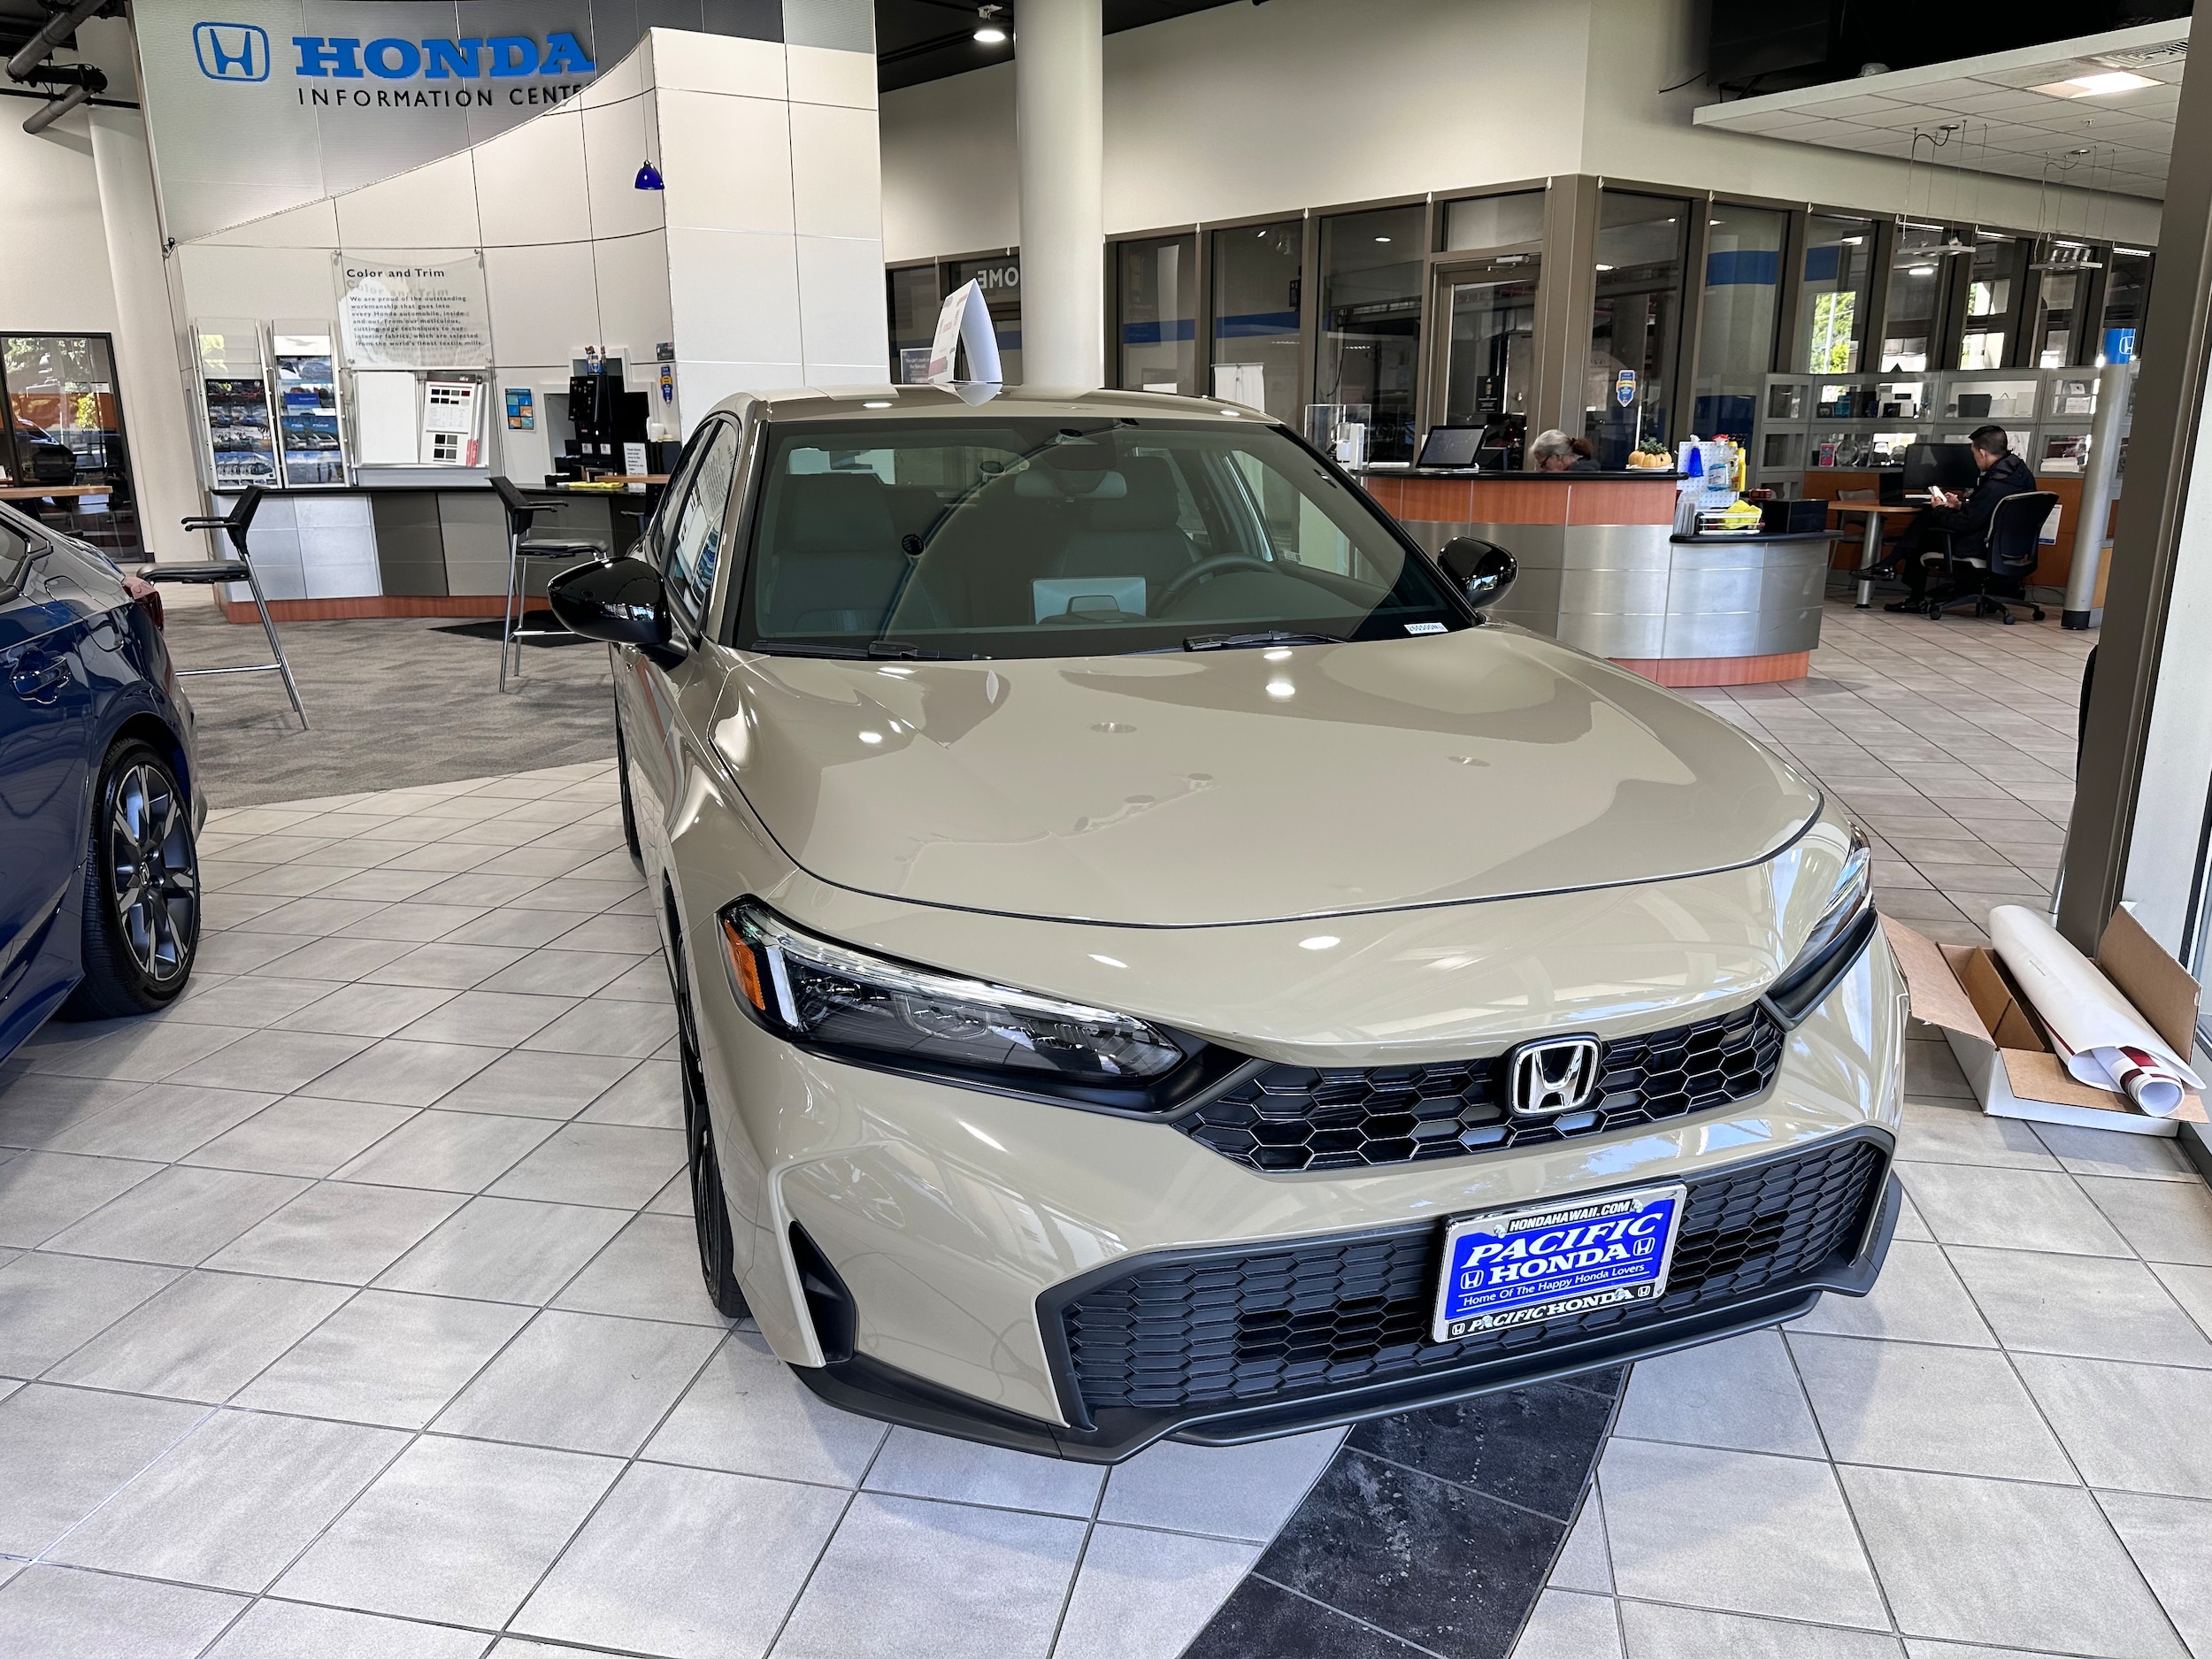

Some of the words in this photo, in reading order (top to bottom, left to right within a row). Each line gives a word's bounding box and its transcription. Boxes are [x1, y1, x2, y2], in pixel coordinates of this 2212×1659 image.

[292, 33, 595, 80] HONDA
[299, 87, 493, 107] INFORMATION
[509, 82, 591, 105] CENT
[346, 269, 383, 277] Color
[388, 269, 411, 277] and
[415, 269, 445, 277] Trim
[1509, 1201, 1630, 1232] HONDAHAWAII.COM
[1460, 1212, 1663, 1269] PACIFIC
[1487, 1242, 1631, 1285] HONDA
[1463, 1293, 1497, 1306] Home
[1499, 1288, 1514, 1298] Of
[1517, 1286, 1535, 1295] The
[1538, 1278, 1572, 1291] Happy
[1575, 1270, 1609, 1284] Honda
[1612, 1264, 1645, 1276] Lovers
[1547, 1289, 1634, 1315] HONDA
